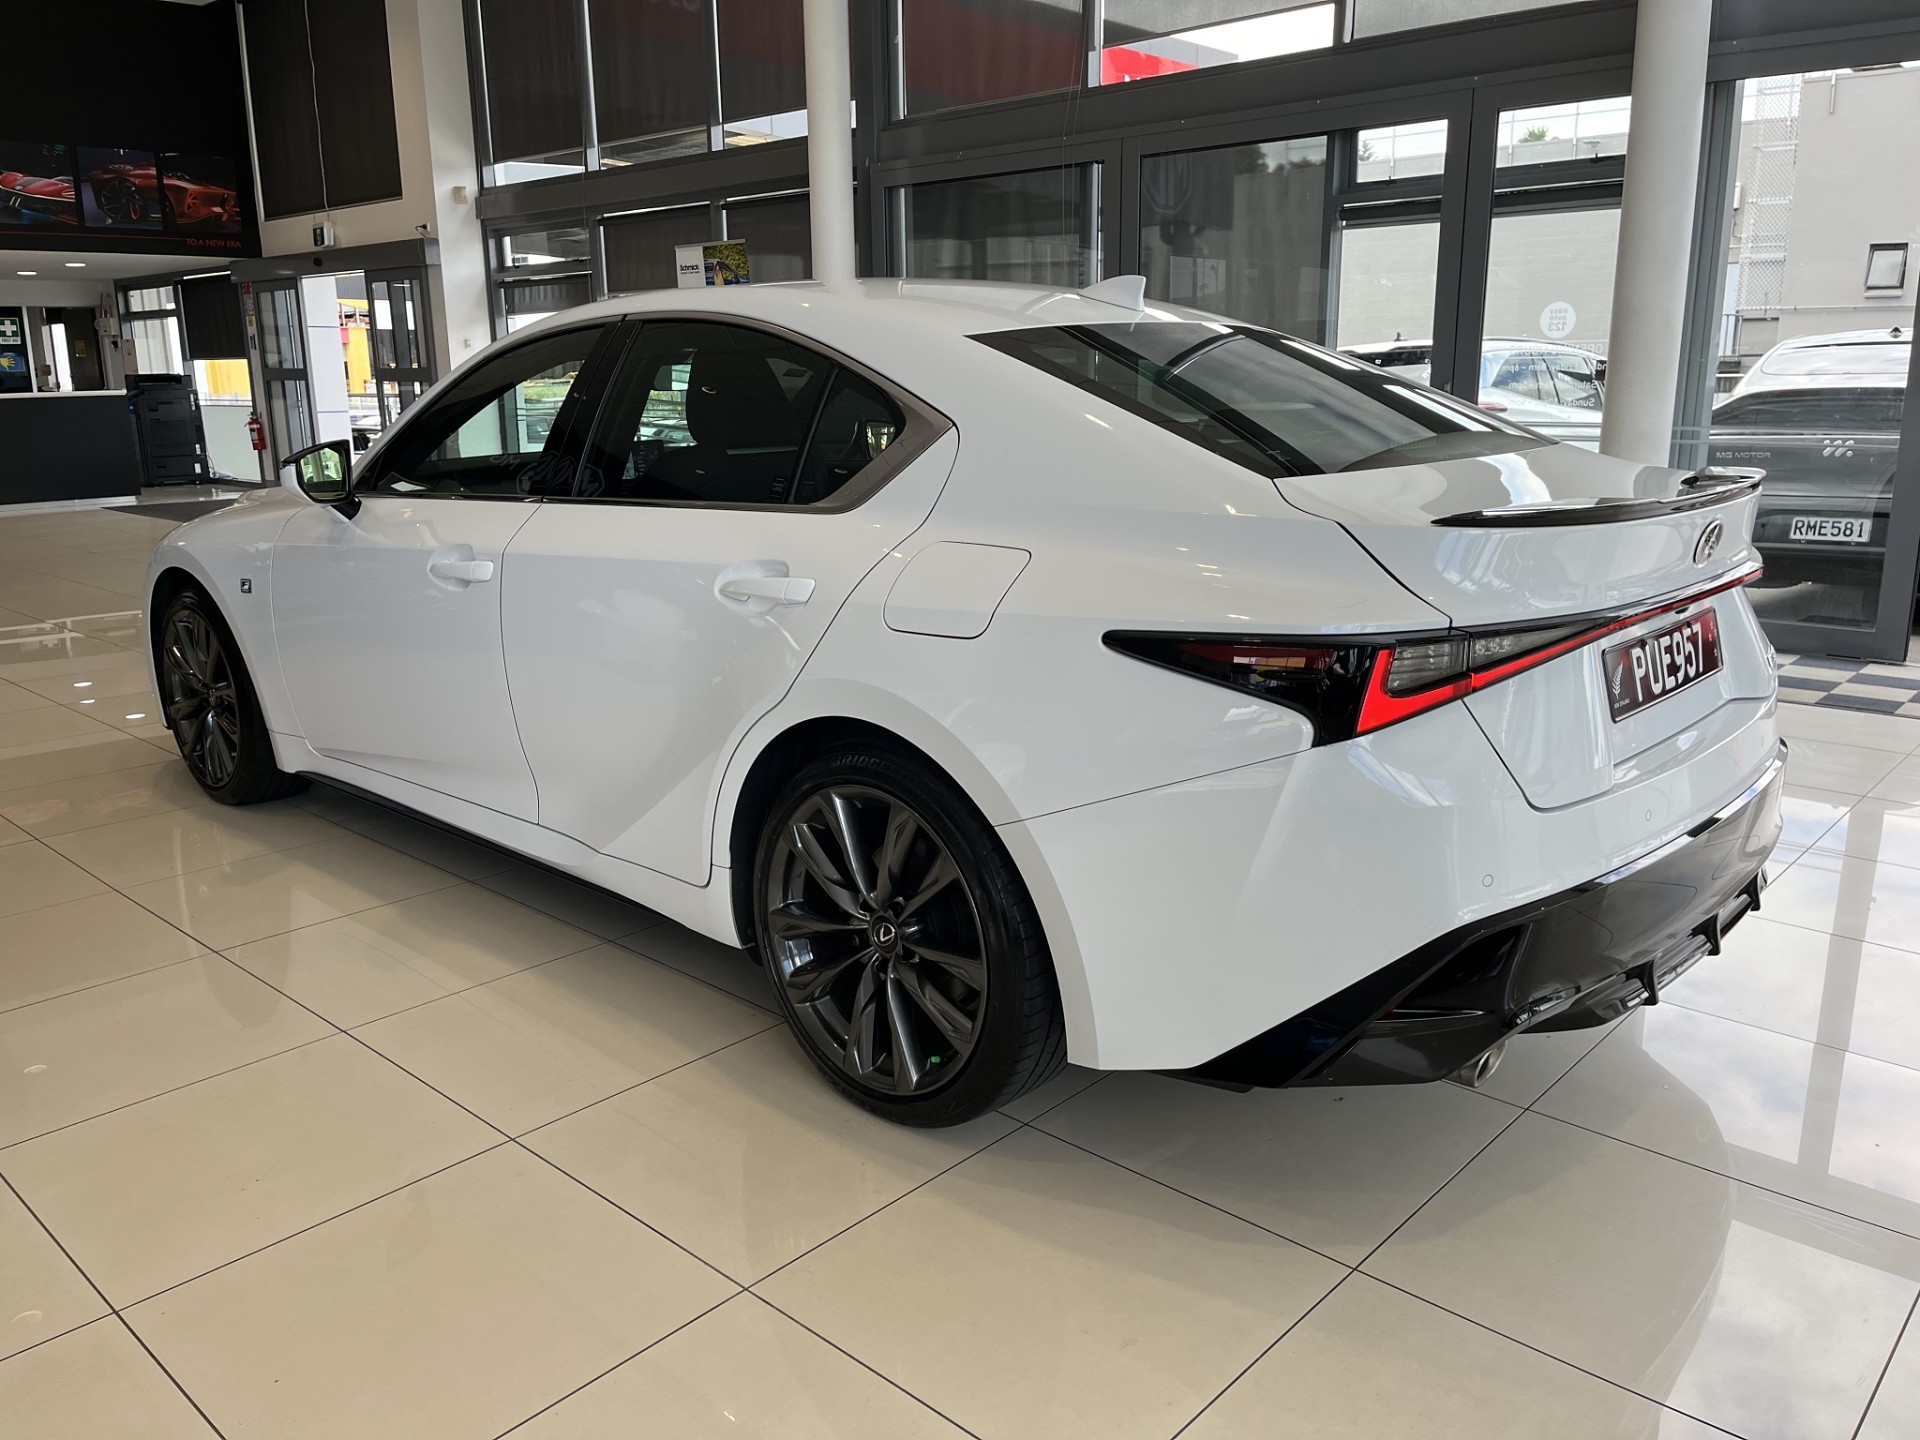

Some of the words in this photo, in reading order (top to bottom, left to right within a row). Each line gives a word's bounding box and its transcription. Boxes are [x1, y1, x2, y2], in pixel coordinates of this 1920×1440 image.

[186, 238, 197, 246] TO
[205, 239, 226, 247] NEW
[226, 240, 241, 248] ERA
[1716, 451, 1733, 459] MG
[1734, 451, 1772, 459] MOTOR
[1793, 519, 1865, 539] RME581
[1630, 621, 1704, 703] PUE957
